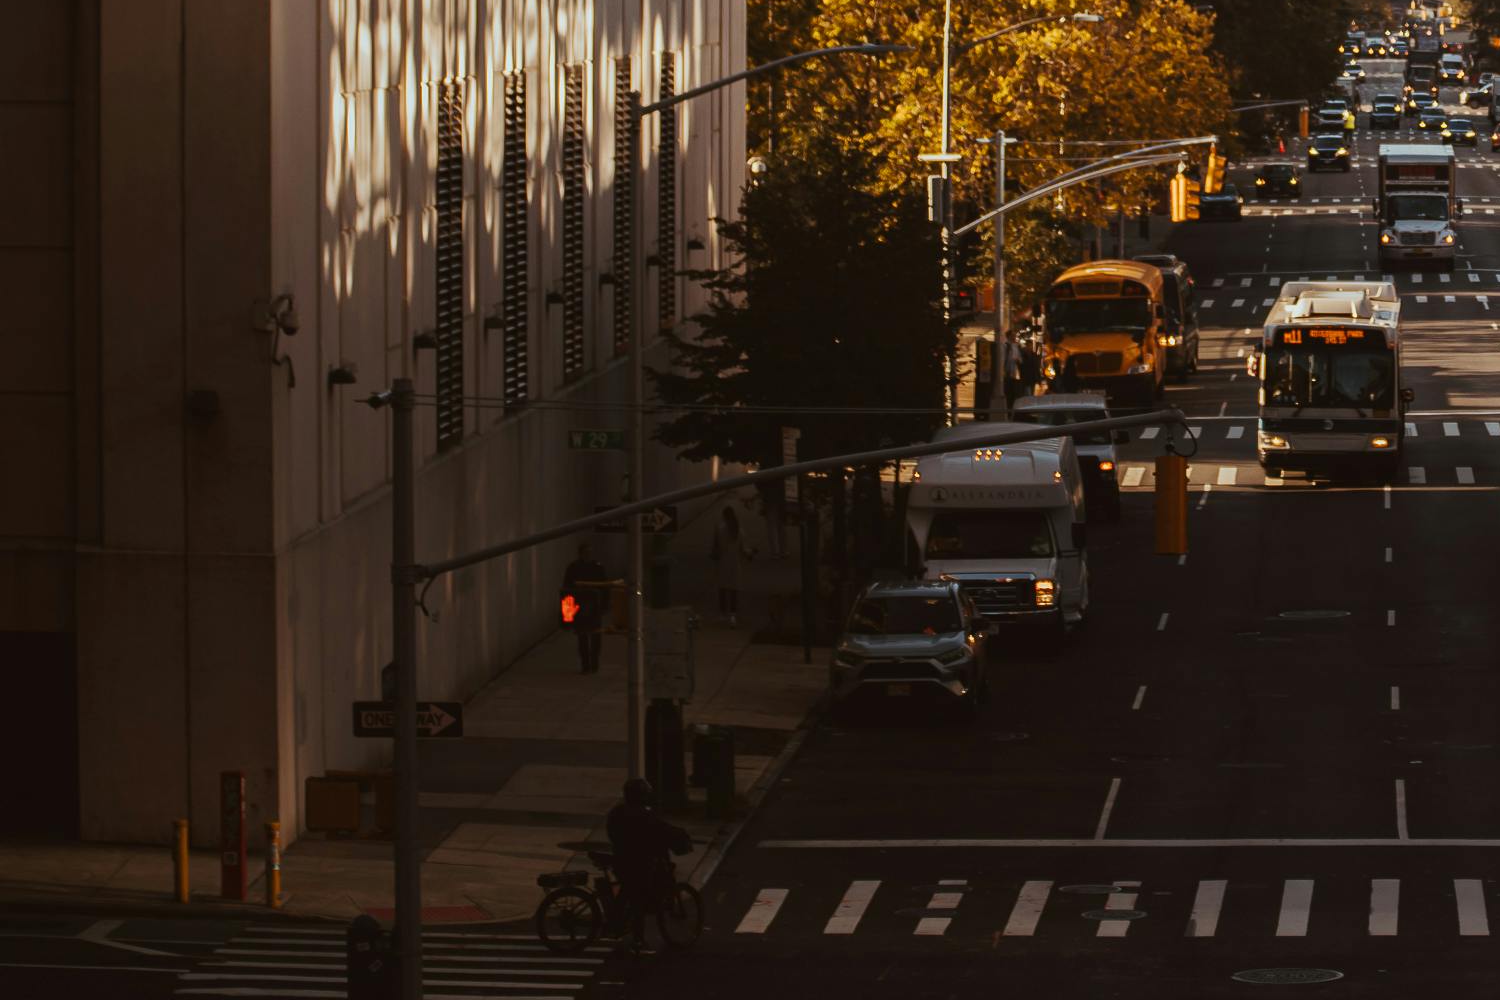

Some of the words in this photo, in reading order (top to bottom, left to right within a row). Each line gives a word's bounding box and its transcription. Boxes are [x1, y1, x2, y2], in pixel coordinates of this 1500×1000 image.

[1283, 329, 1302, 344] M11
[571, 431, 584, 448] W
[589, 431, 609, 449] 29
[952, 490, 1045, 499] ALEXANDRIA
[364, 712, 393, 727] ONE
